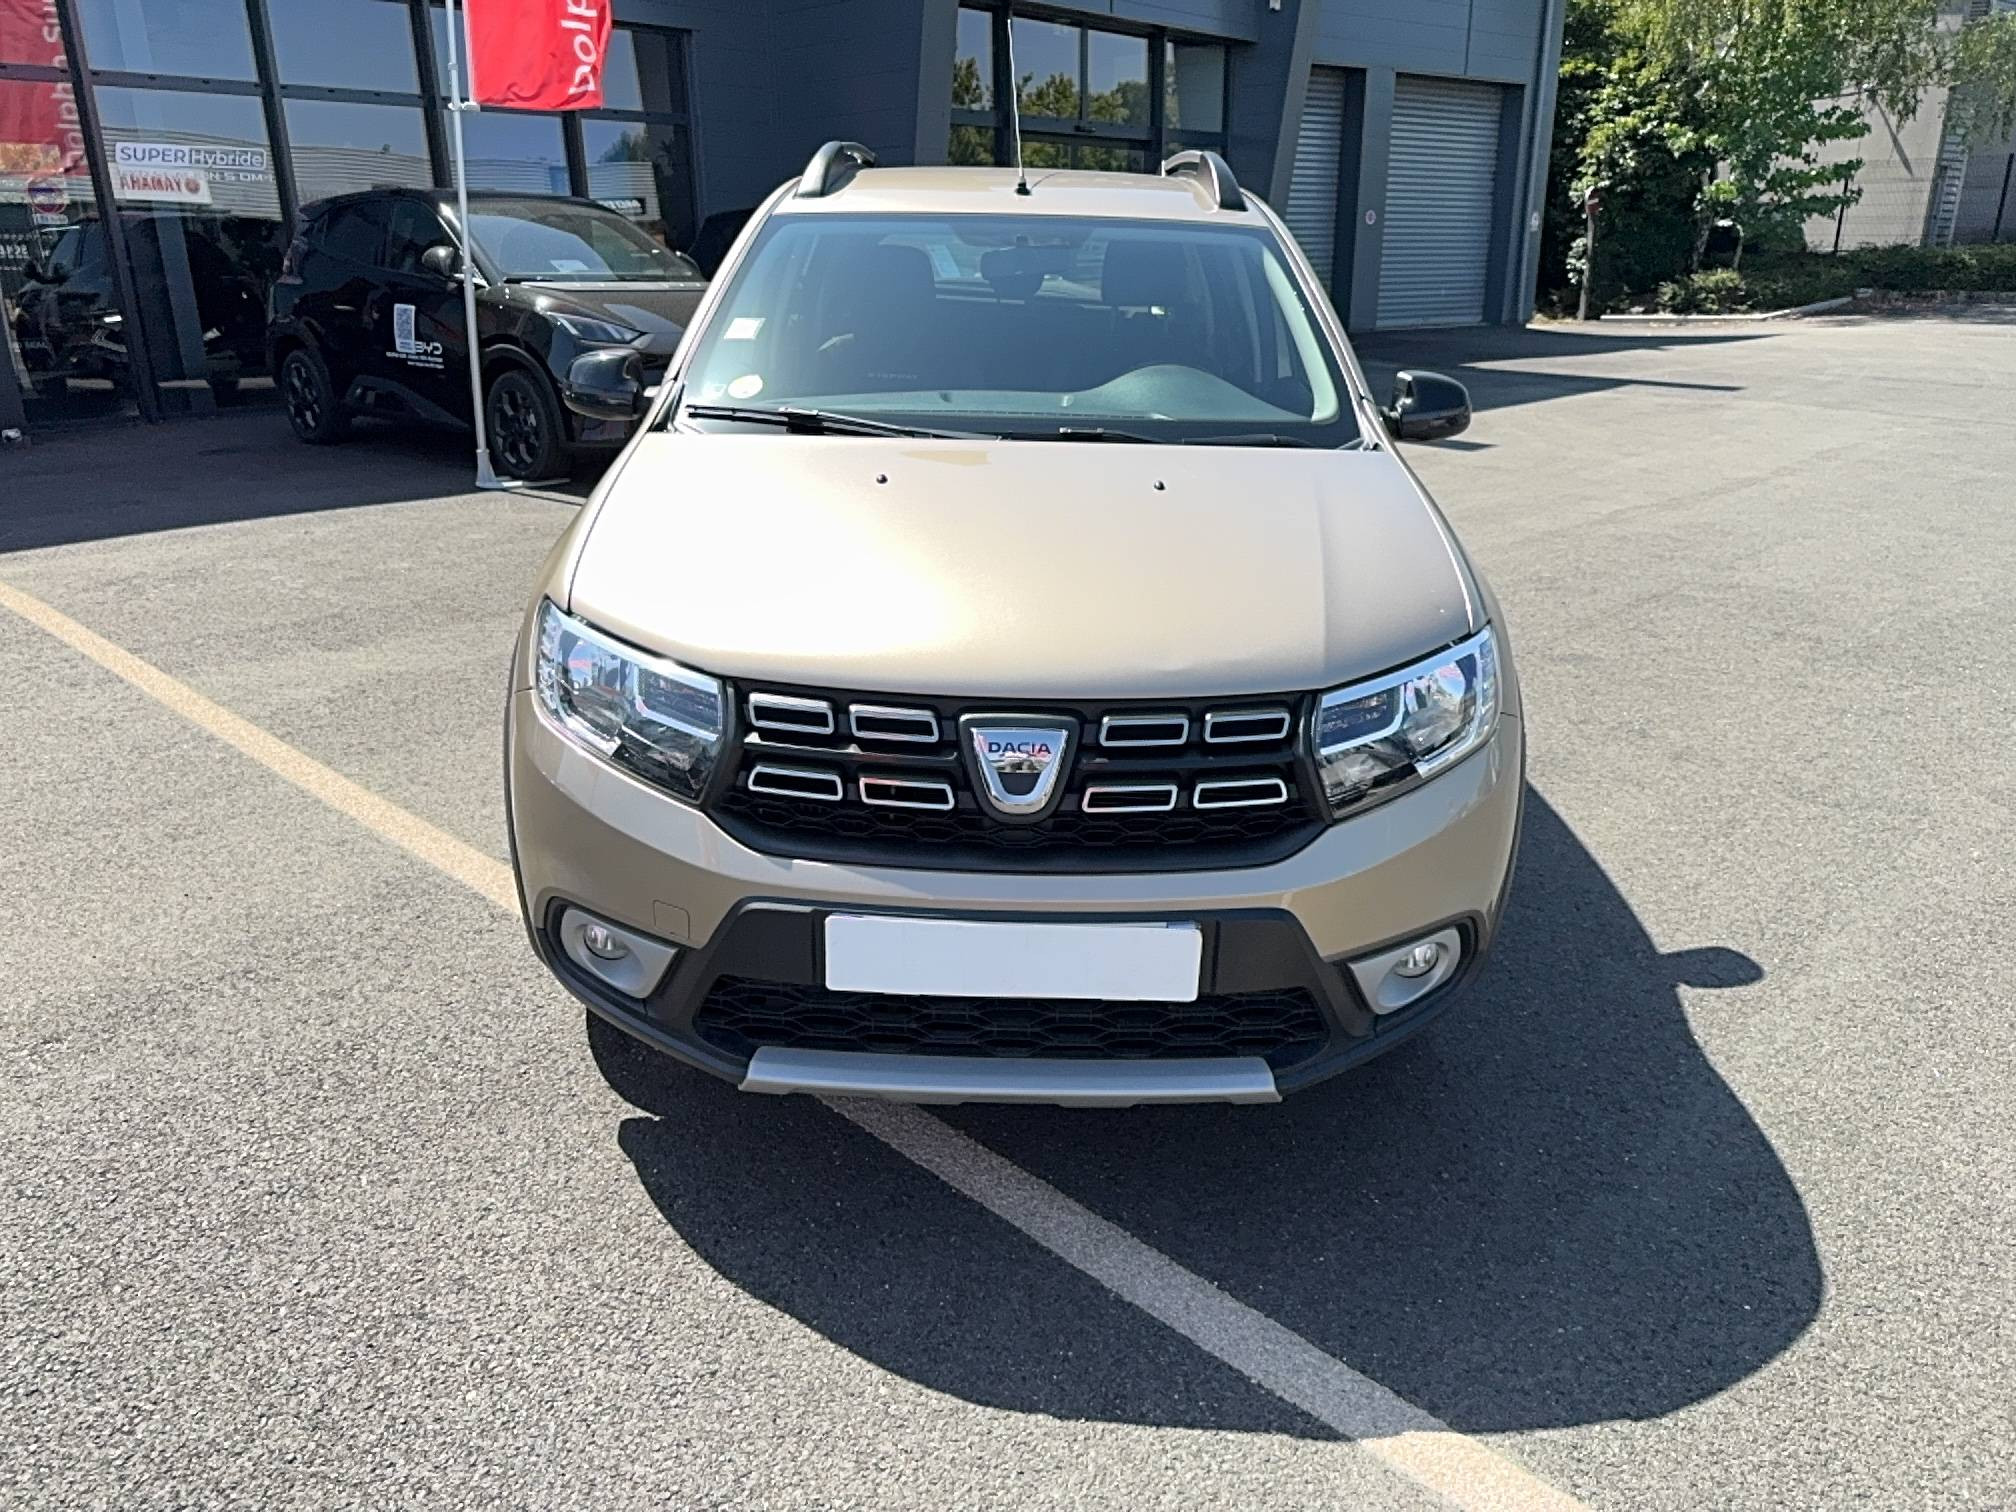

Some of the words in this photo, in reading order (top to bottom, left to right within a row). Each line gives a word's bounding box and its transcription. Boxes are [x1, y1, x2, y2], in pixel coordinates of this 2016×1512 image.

[119, 146, 187, 163] SUPER
[192, 150, 263, 168] Hybride
[988, 742, 1052, 755] DACIA
